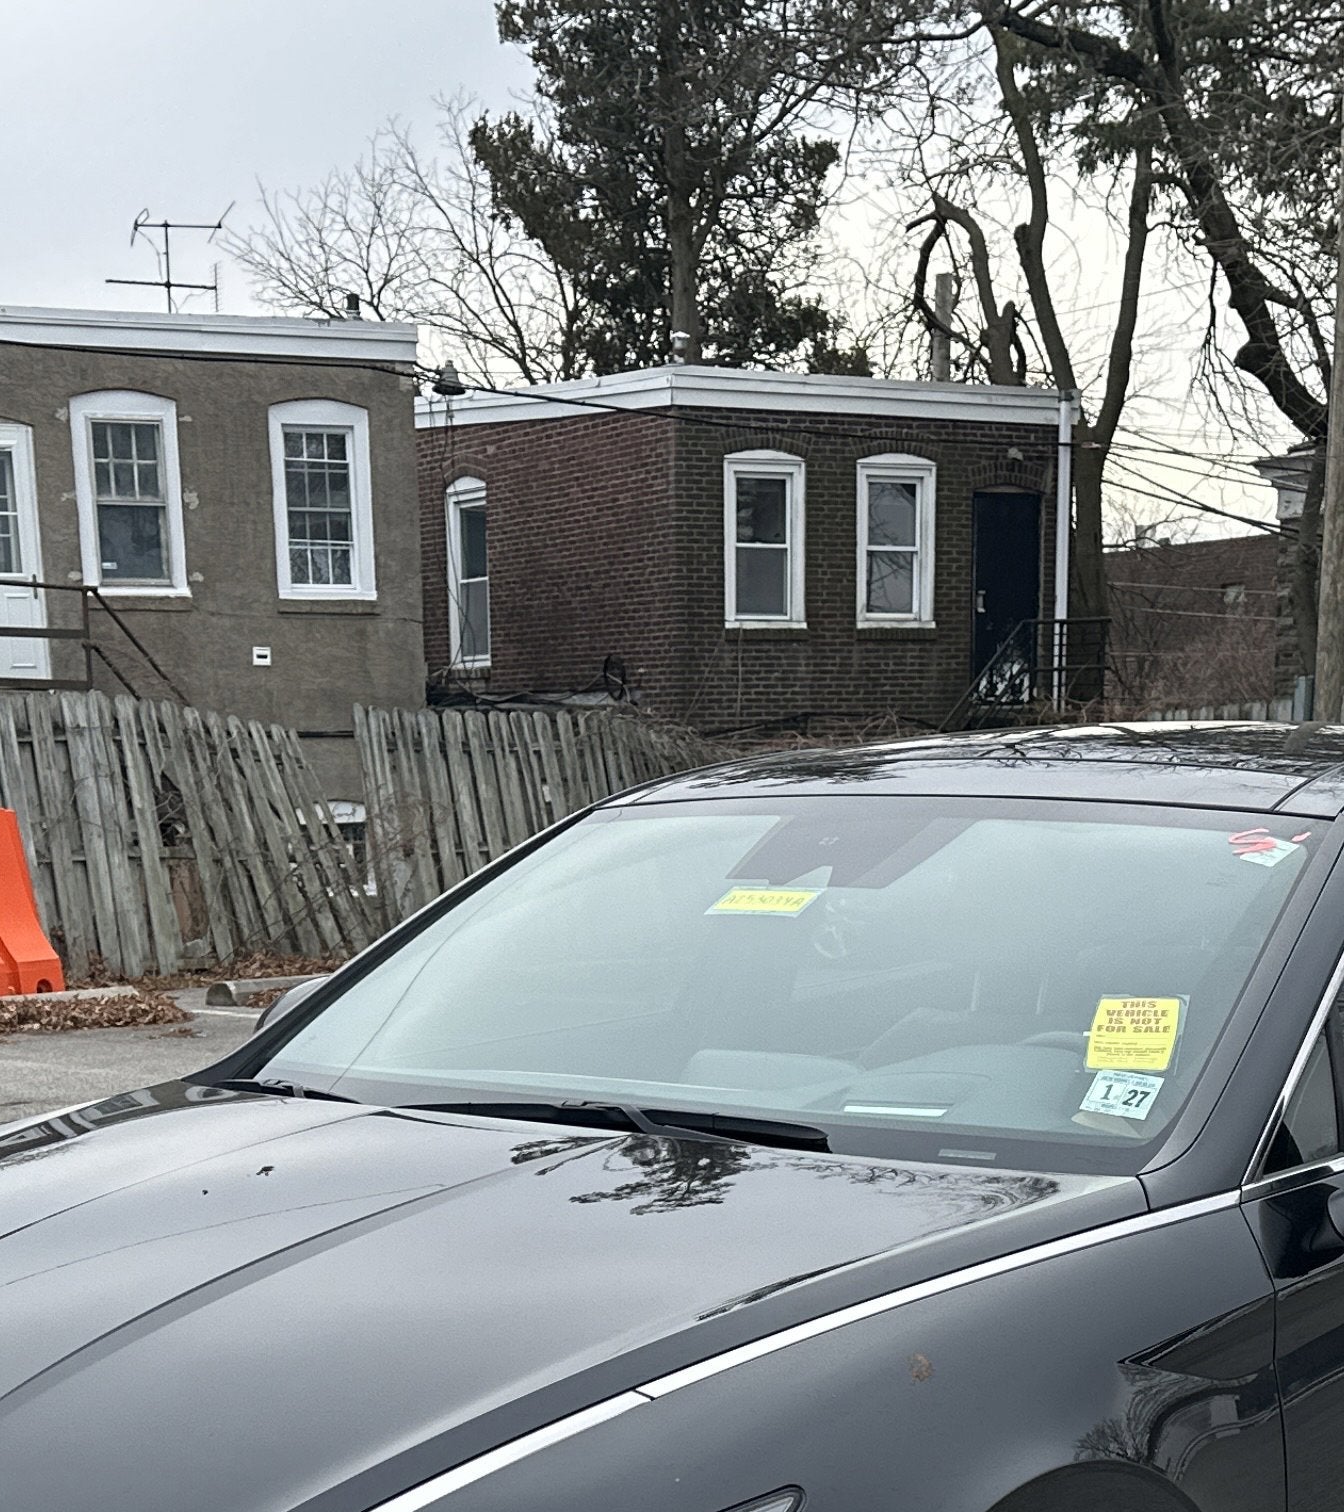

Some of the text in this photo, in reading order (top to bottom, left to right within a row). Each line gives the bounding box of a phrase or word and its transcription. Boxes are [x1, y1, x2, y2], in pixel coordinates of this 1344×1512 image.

[1107, 1009, 1169, 1017] VEHICLE
[1097, 1025, 1126, 1033] FOR
[1100, 1085, 1114, 1100] 1
[1122, 1090, 1151, 1108] 27
